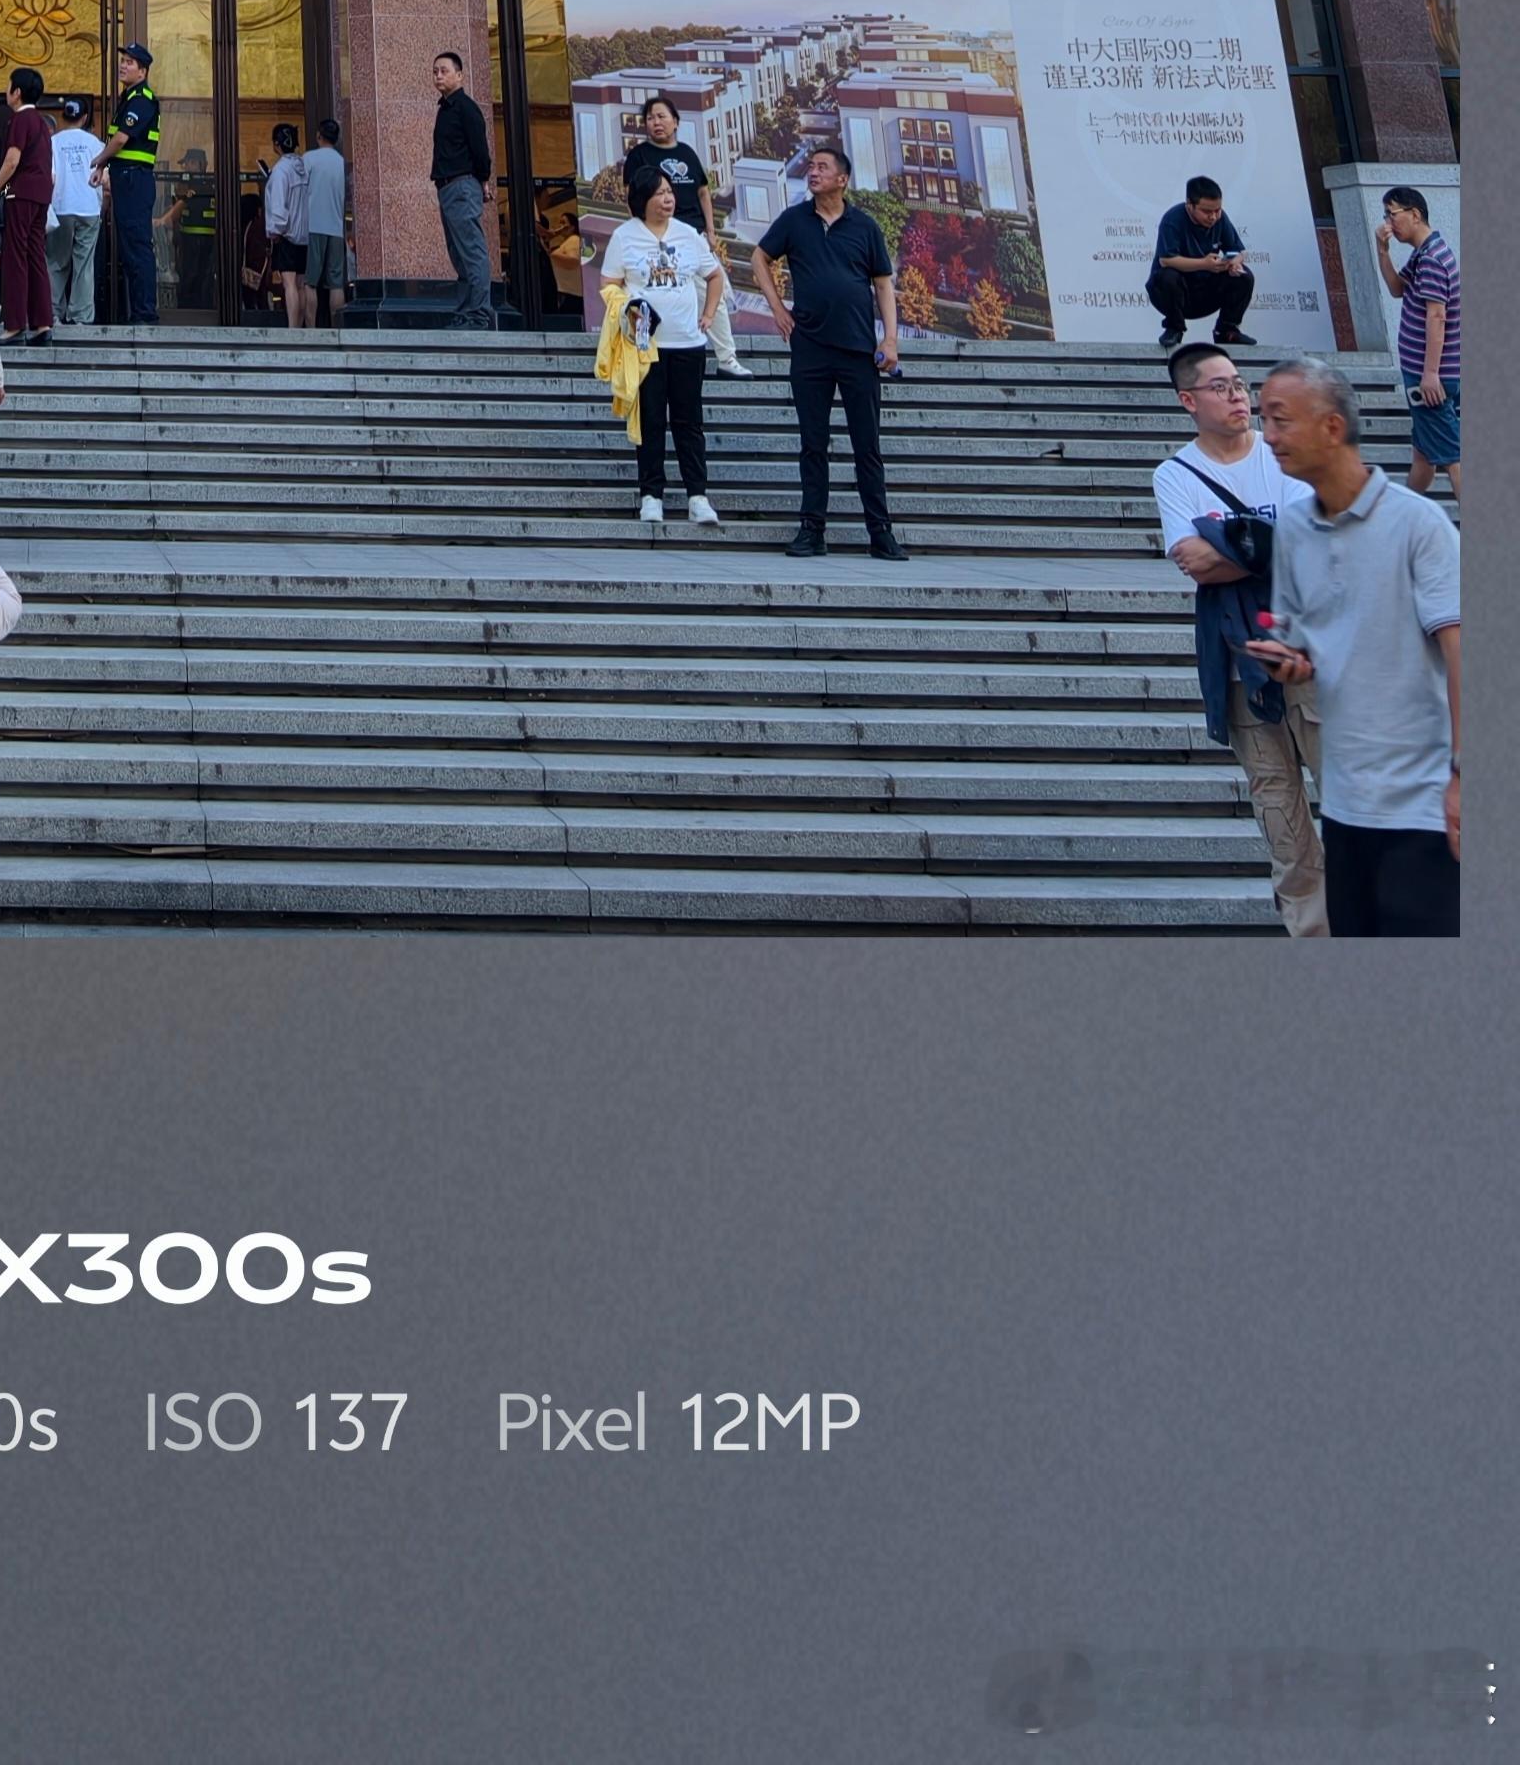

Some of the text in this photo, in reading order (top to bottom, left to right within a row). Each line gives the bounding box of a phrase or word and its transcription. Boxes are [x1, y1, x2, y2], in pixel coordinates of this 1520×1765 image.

[1067, 37, 1243, 63] 中大国际99二期
[1043, 65, 1277, 91] 谨呈33席 新法式院墅
